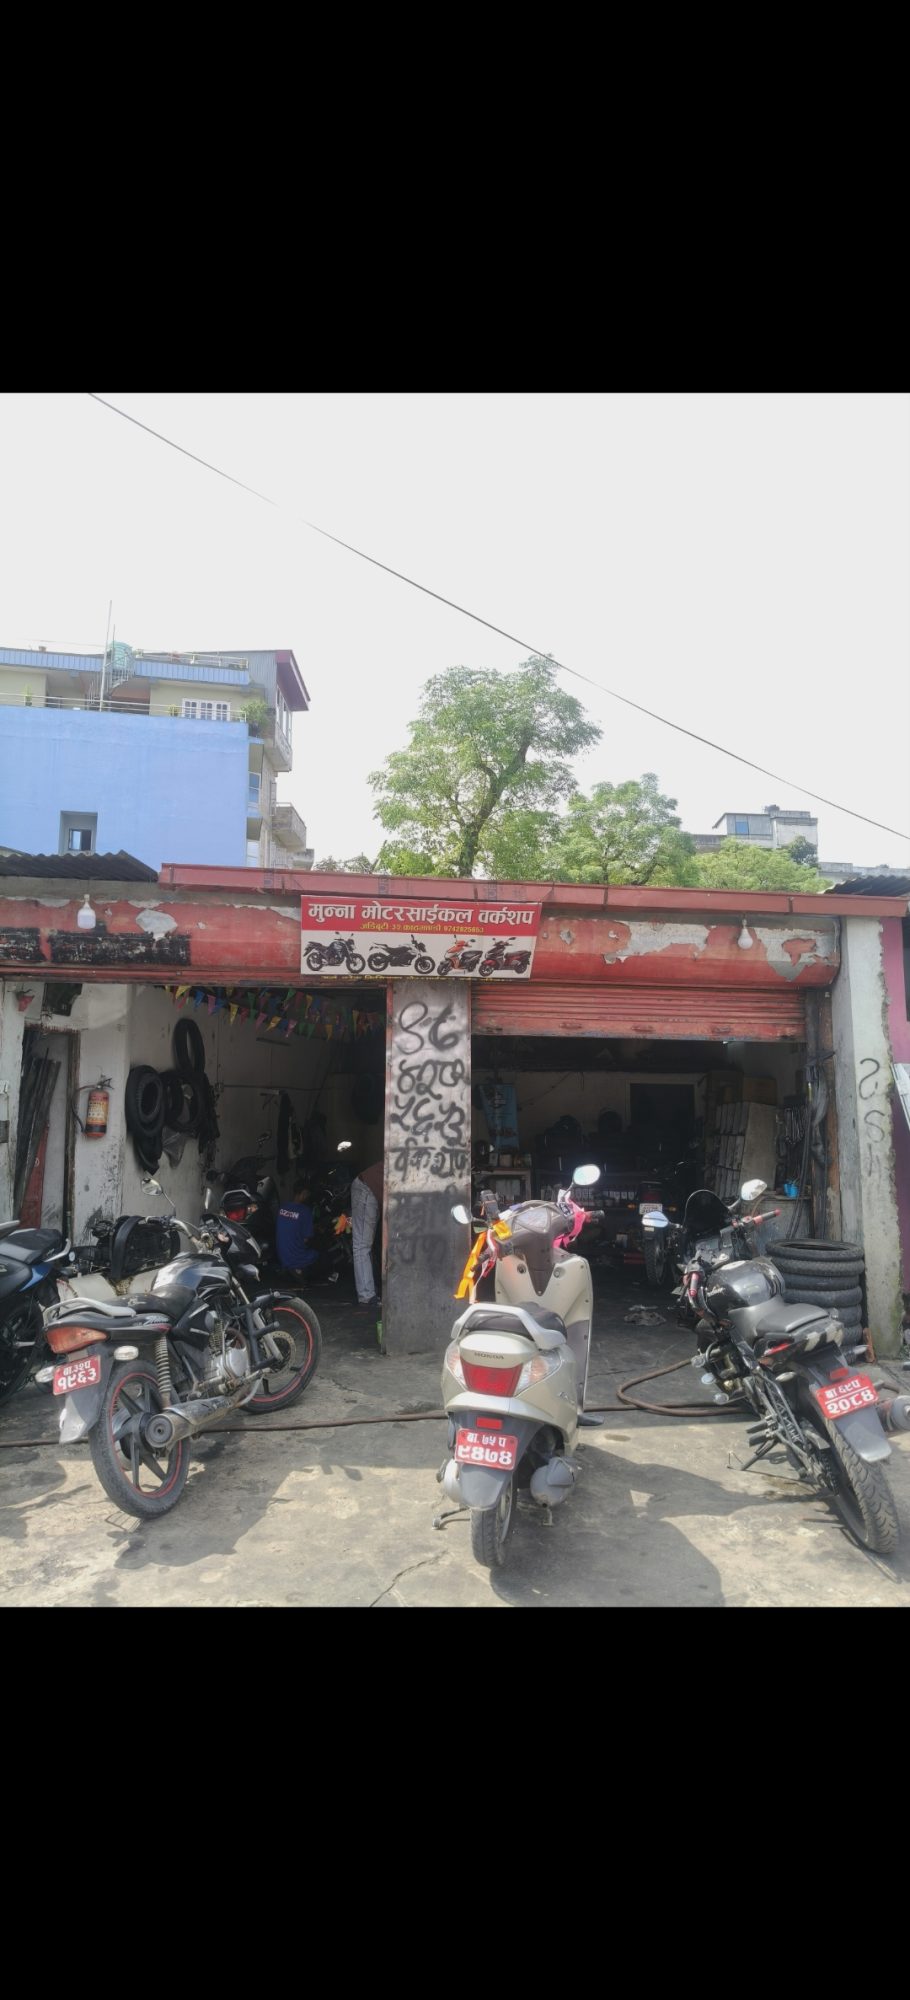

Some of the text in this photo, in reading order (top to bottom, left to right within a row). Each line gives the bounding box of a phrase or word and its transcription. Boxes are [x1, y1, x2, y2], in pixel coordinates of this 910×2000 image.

[308, 901, 535, 926] मुन्ना मोटरसाईकल वर्कशप
